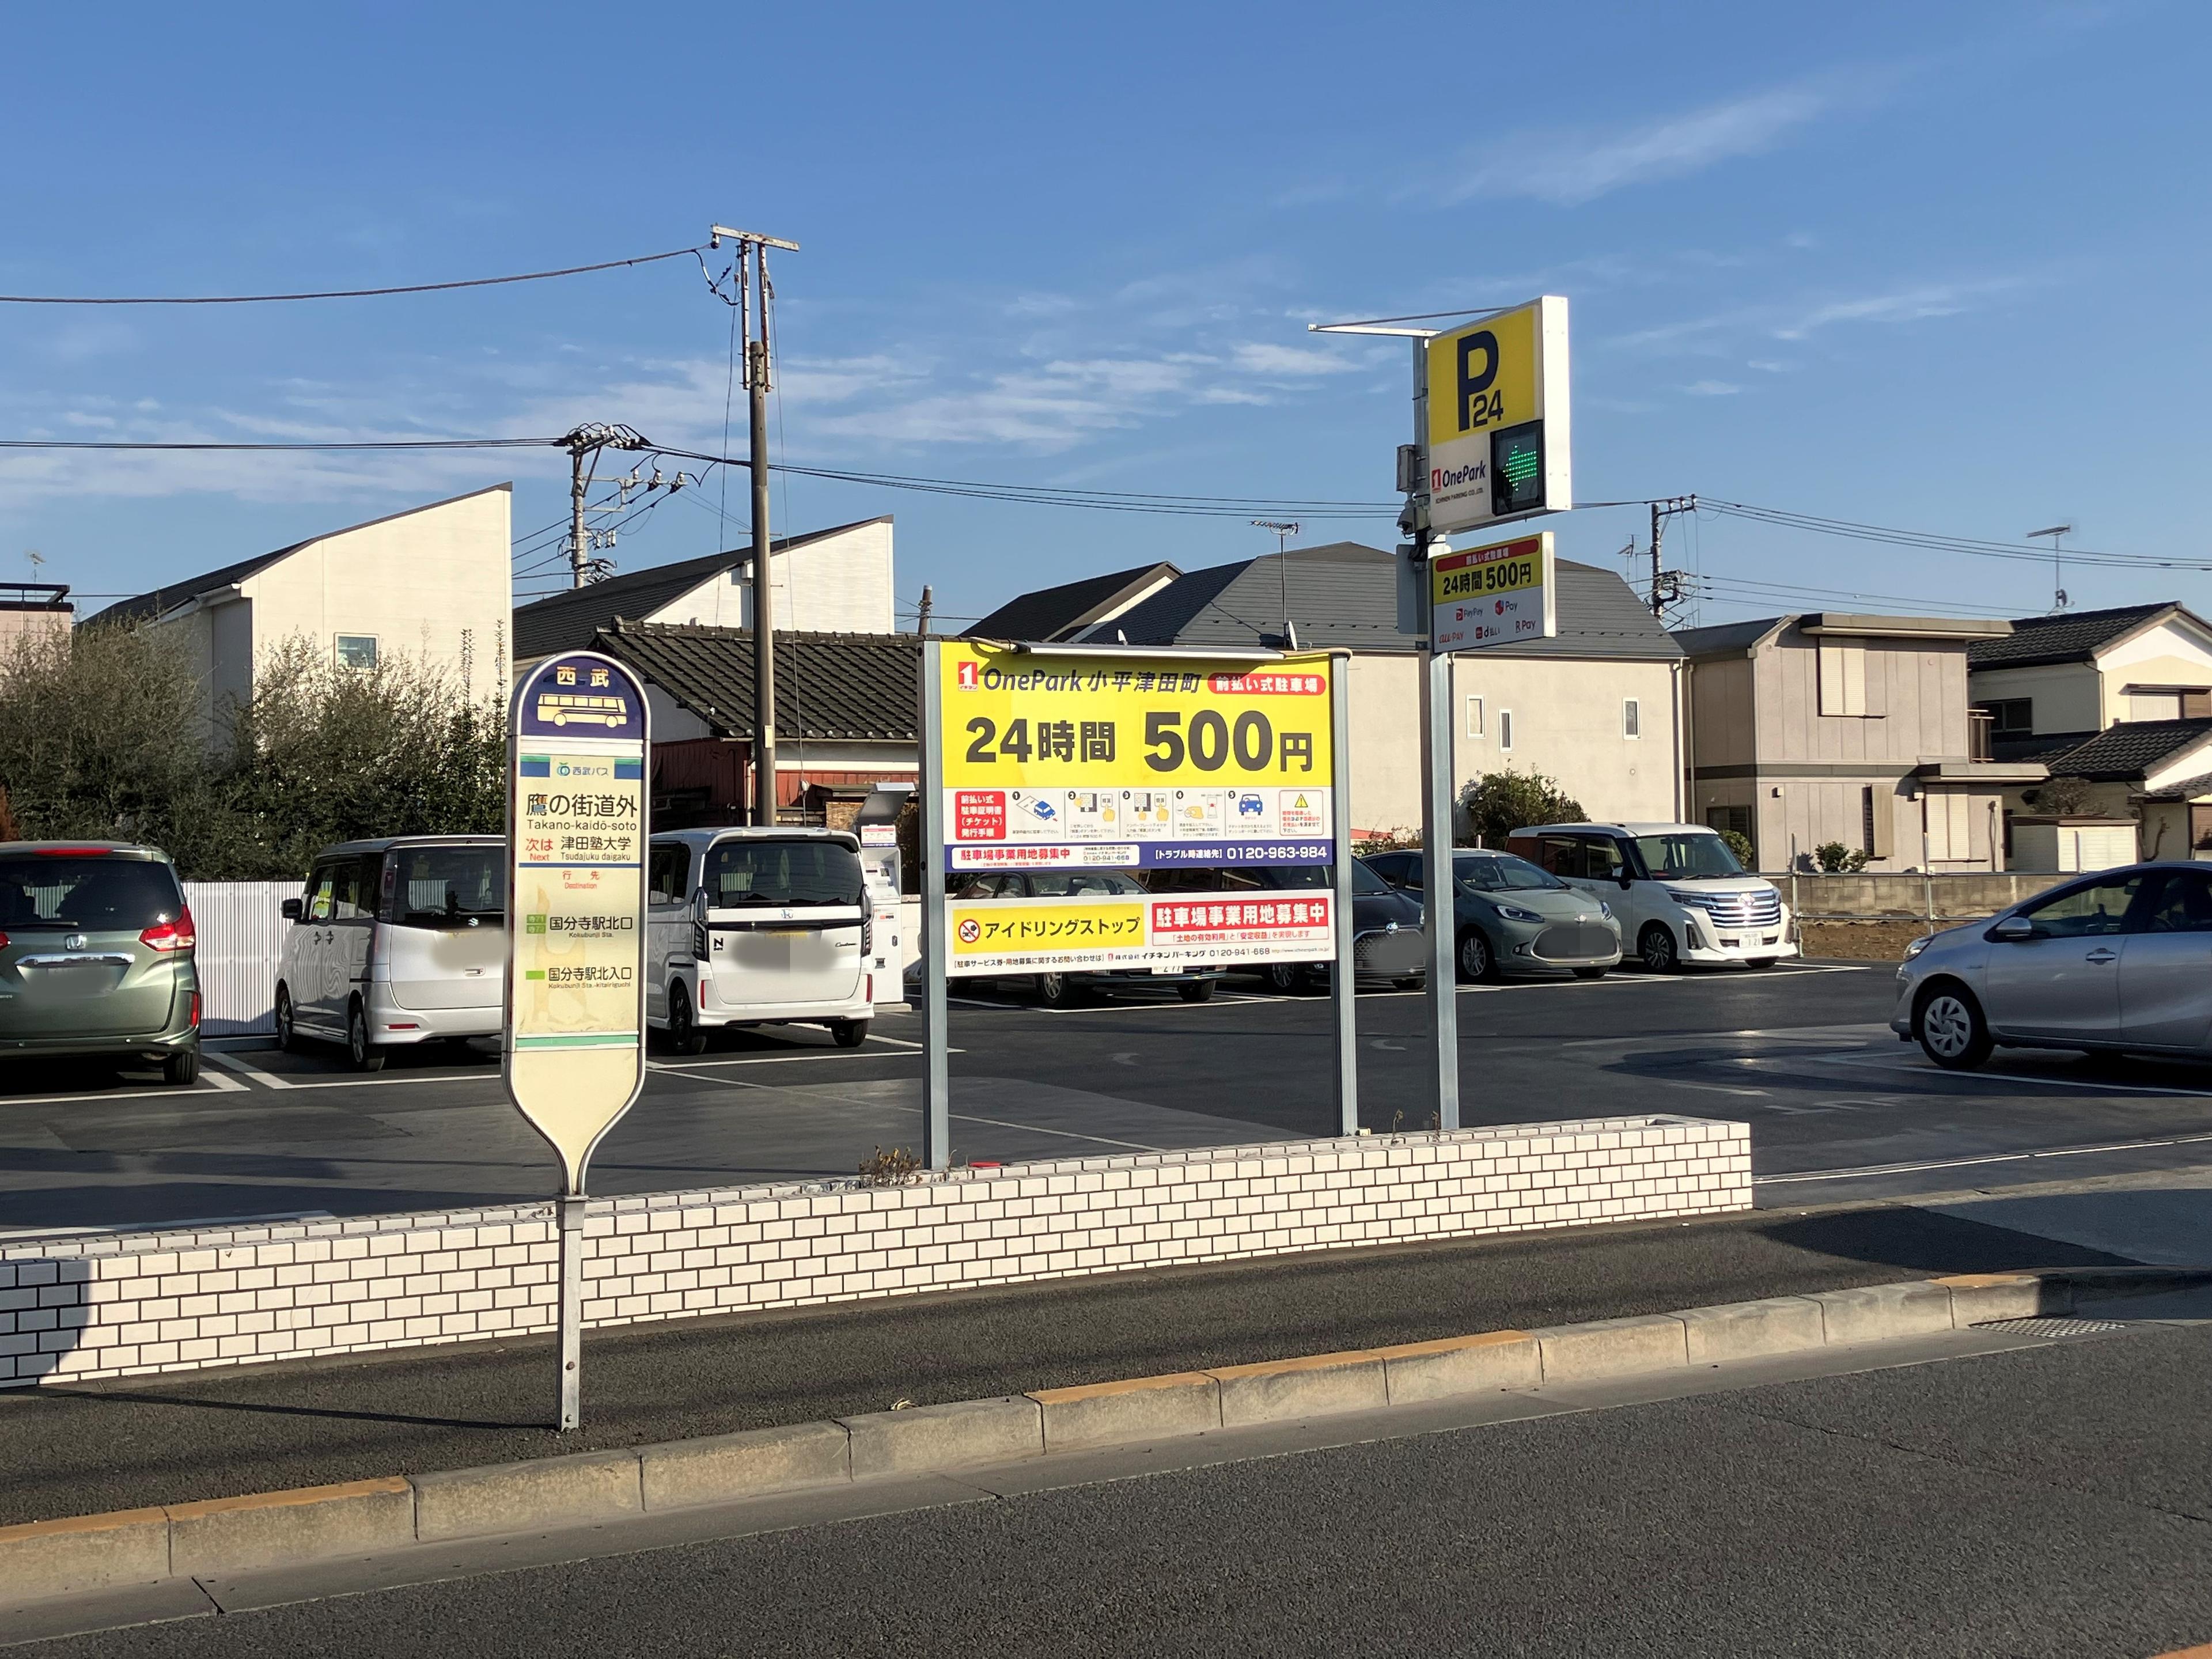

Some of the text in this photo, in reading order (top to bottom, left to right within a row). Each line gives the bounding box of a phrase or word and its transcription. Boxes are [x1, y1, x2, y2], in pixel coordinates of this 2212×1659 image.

[1457, 330, 1499, 432] P
[1472, 389, 1503, 428] 24
[1442, 460, 1486, 487] OnePark
[1443, 562, 1531, 596] 24時間 500円
[1464, 608, 1483, 618] PayPay
[1505, 601, 1518, 612] Pay
[1522, 620, 1536, 631] Pay
[557, 666, 609, 687] 西武
[984, 668, 1082, 691] OnePark
[1086, 670, 1202, 694] 小平津田町
[1215, 676, 1319, 694] 前払い式駐車場
[965, 709, 1313, 772] 24時間 500円
[573, 767, 608, 776] 西武バス
[526, 793, 637, 818] 鷹の街道外
[961, 795, 994, 804] 前払い式
[961, 828, 995, 838] 発行手順
[525, 836, 631, 851] 次は 津田塾大学
[529, 852, 631, 862] Next Tsudajuku daigaku
[961, 848, 1070, 861] 駐車場事業用地募集中
[1227, 847, 1327, 859] 0120-963-984
[550, 916, 632, 930] 国分寺駅北口
[1156, 903, 1325, 929] 駐車場事業用地募集中
[985, 917, 1141, 939] アイドリングストップ
[548, 967, 632, 981] 国分寺駅北入口
